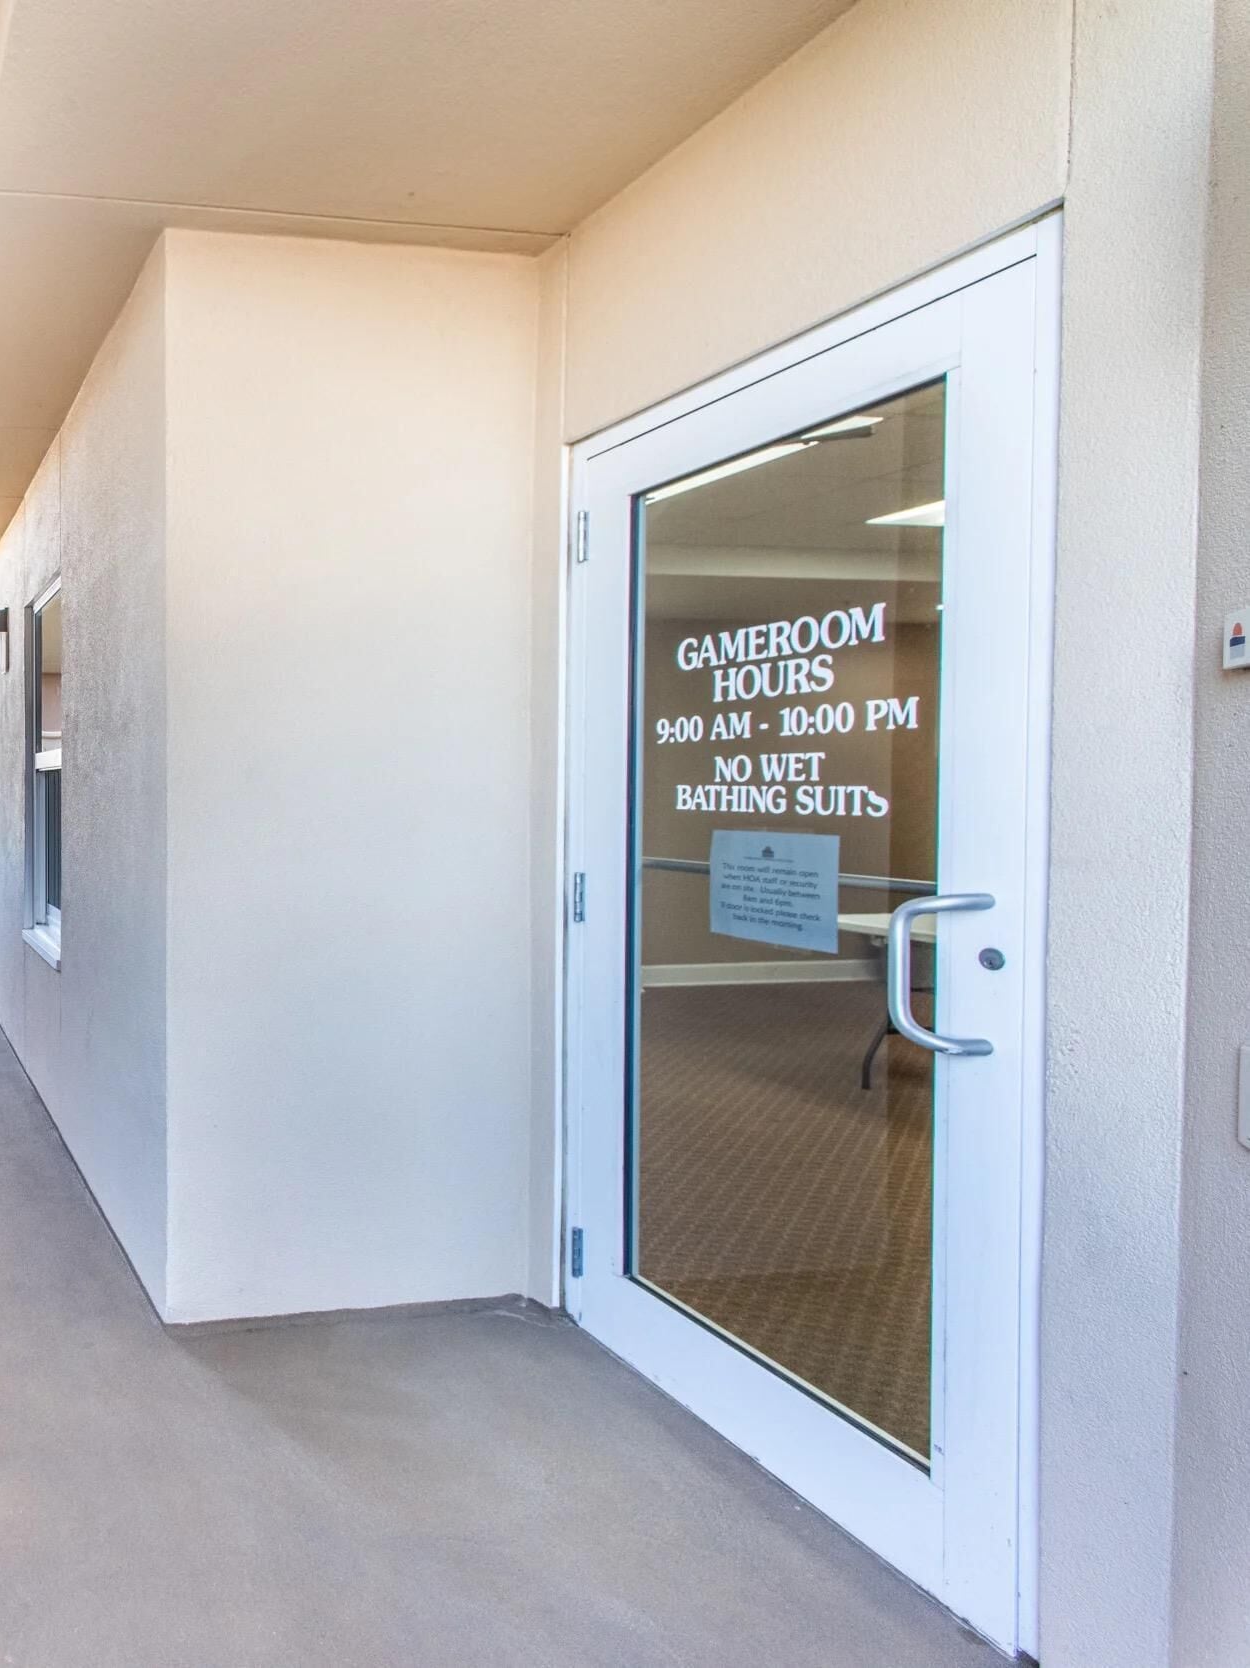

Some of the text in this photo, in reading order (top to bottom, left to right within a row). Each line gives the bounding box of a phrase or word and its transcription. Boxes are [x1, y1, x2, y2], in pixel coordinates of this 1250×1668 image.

[677, 602, 887, 671] GAMEROOM
[713, 654, 835, 703] HOURS
[656, 715, 704, 745] 9:00
[709, 711, 753, 741] AM
[779, 701, 855, 737] 10:00
[865, 696, 920, 732] PM
[714, 751, 826, 783] NO WET
[675, 784, 889, 818] BATHING SUITS
